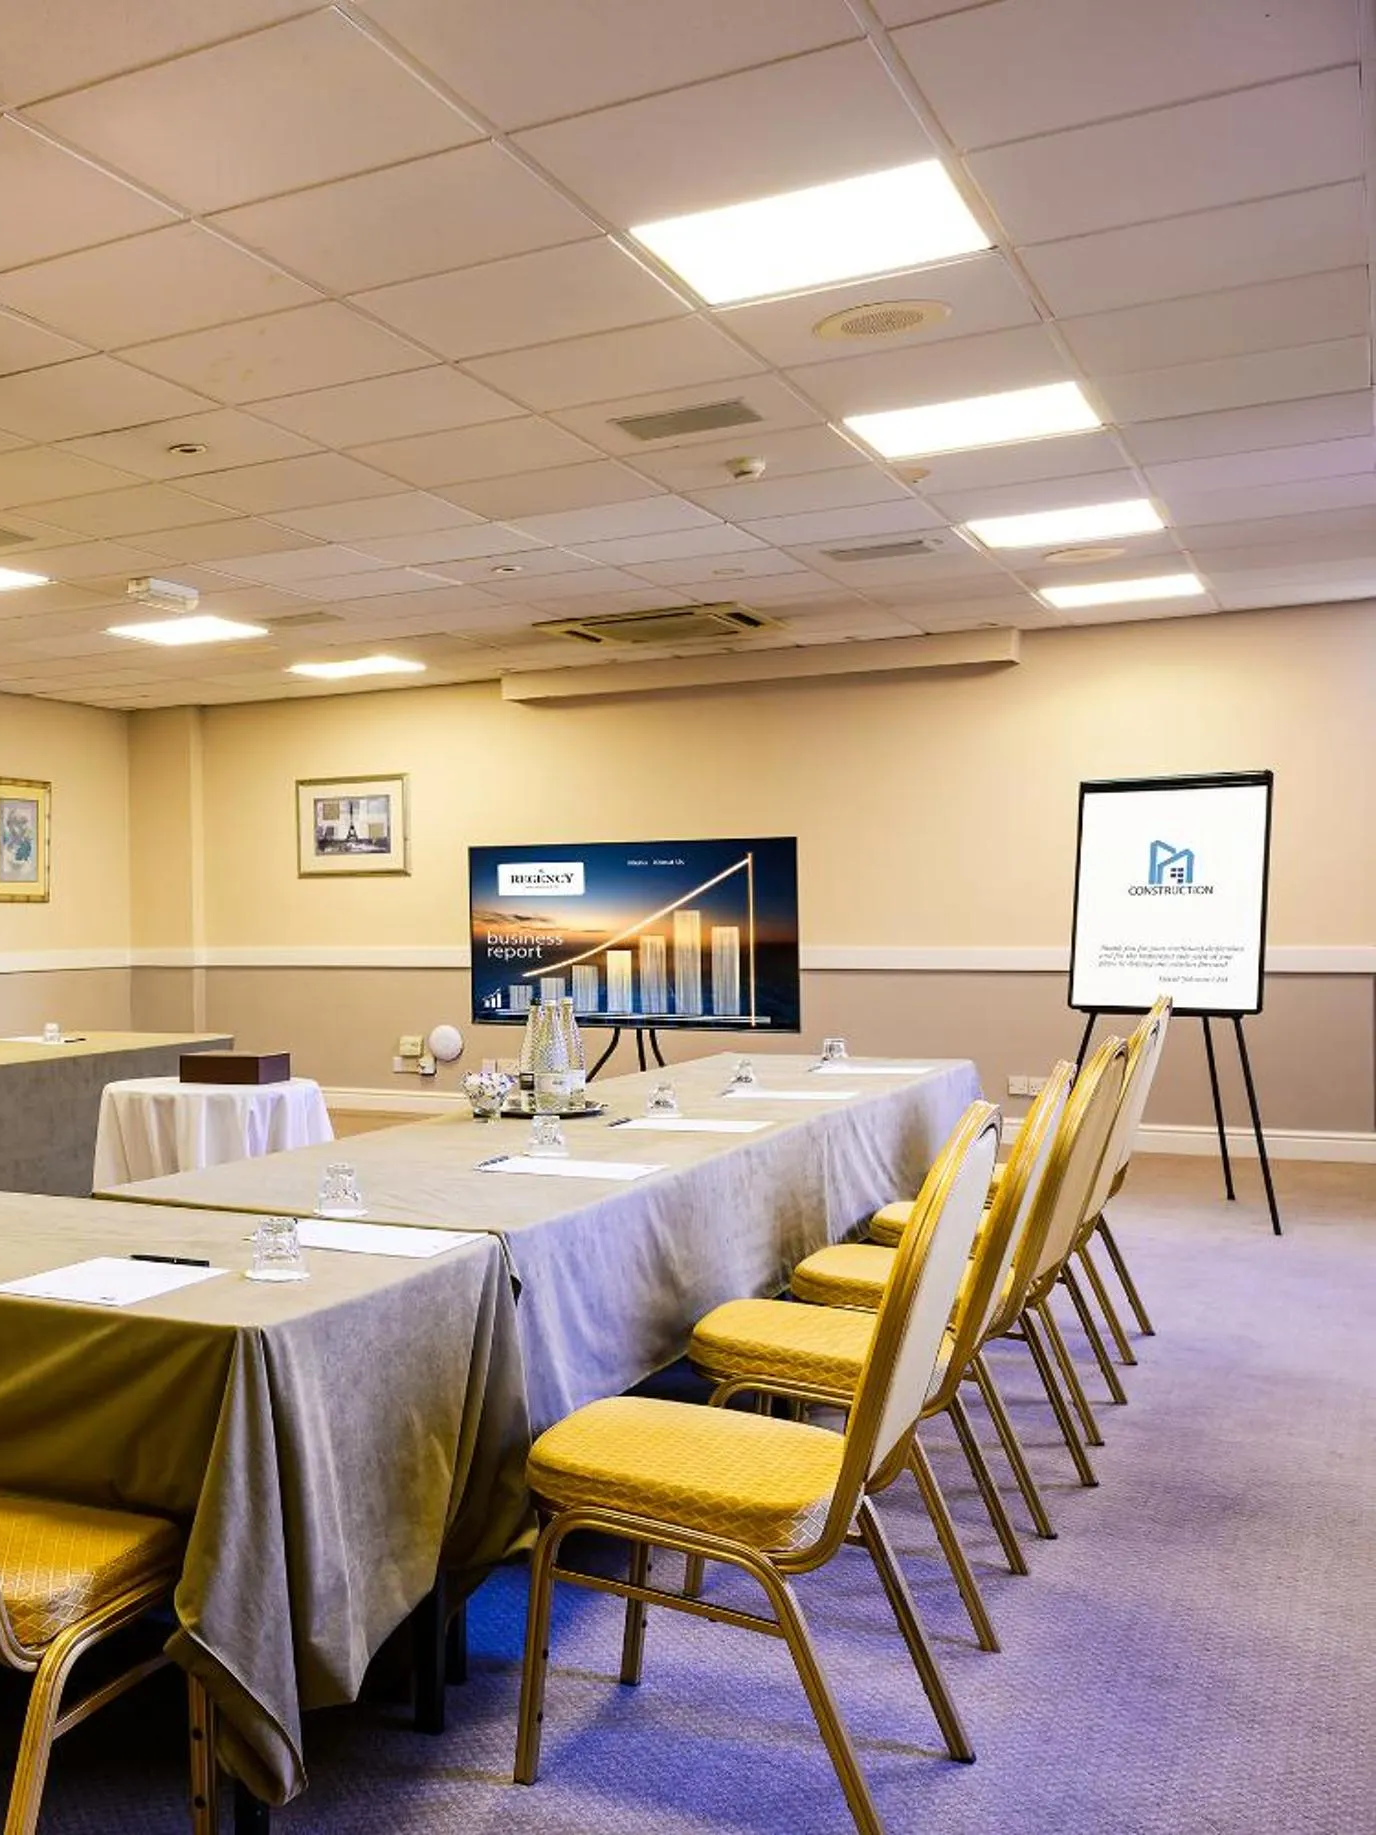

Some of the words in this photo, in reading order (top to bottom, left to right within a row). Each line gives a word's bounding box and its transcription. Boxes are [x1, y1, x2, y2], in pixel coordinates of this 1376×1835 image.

[511, 873, 574, 884] REGENCY
[1128, 886, 1214, 896] CONSTRUCTION
[487, 930, 563, 946] business
[487, 945, 543, 961] report
